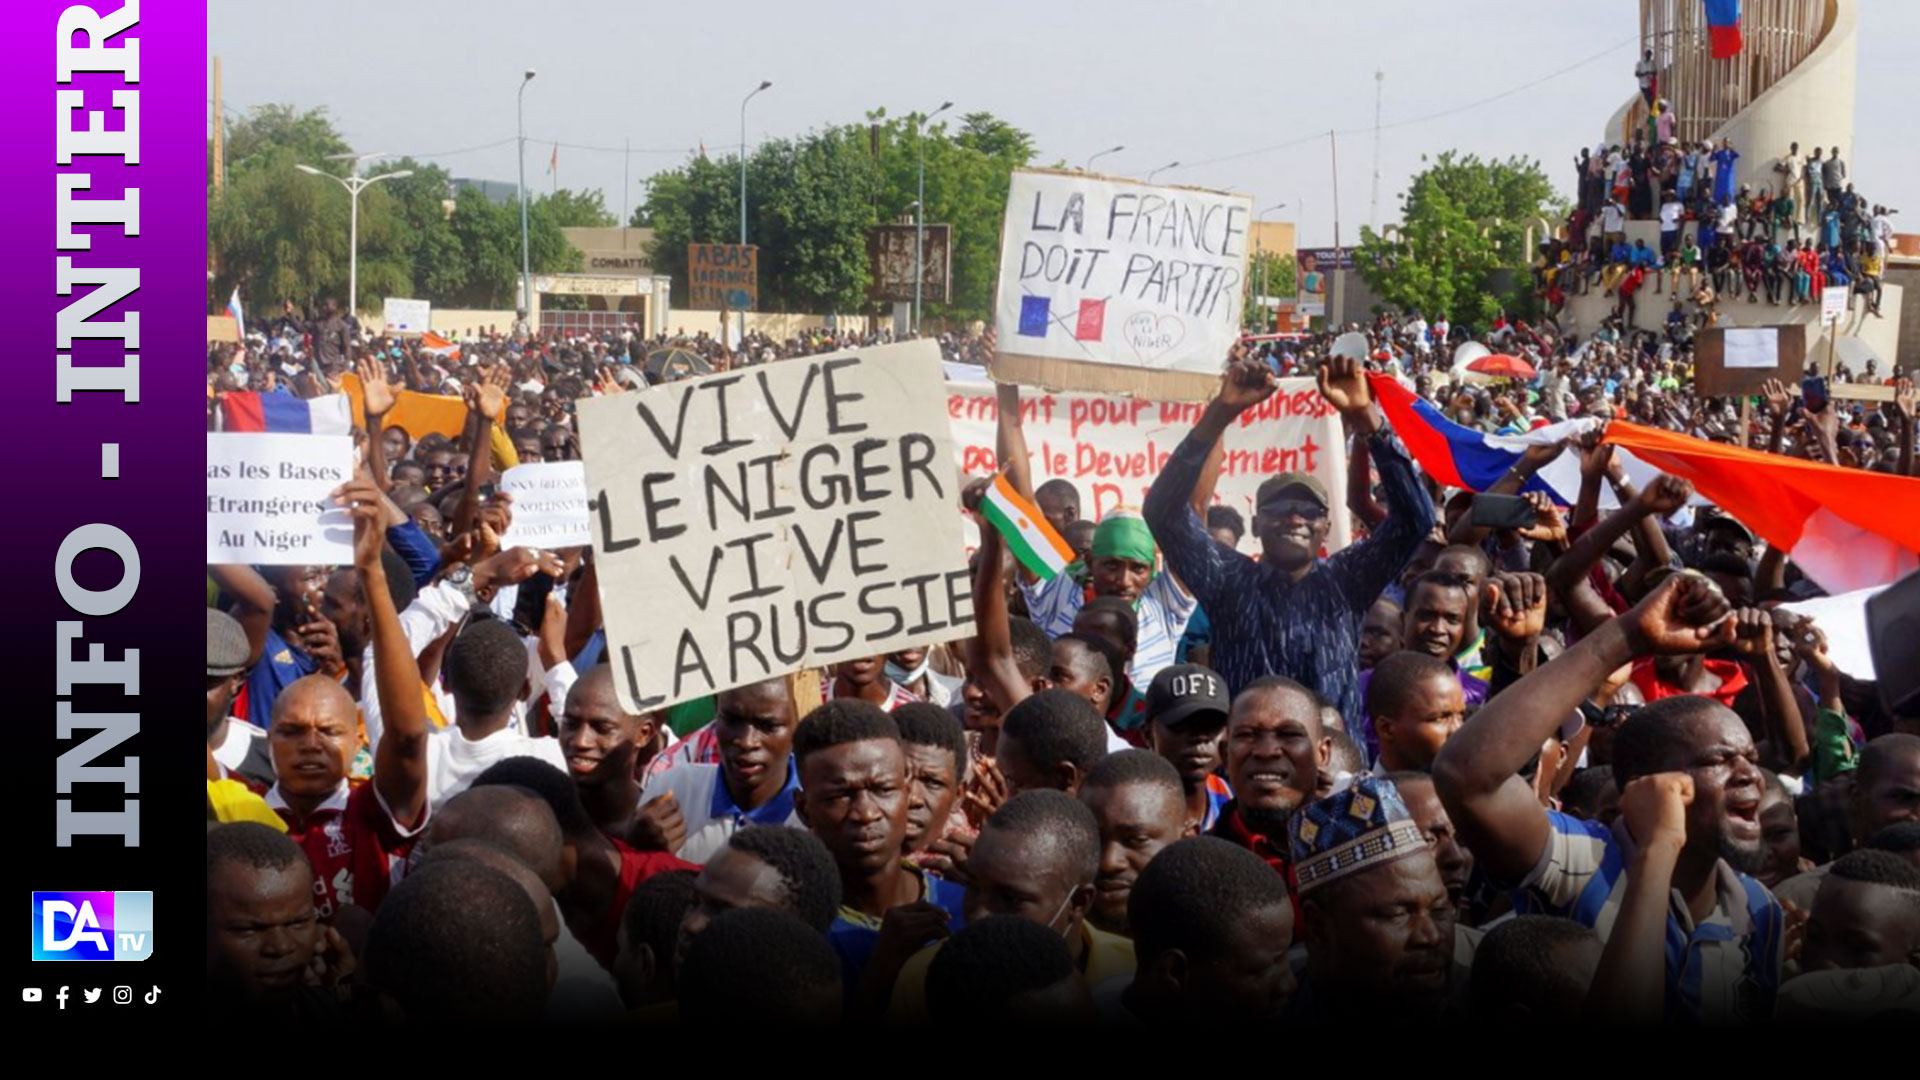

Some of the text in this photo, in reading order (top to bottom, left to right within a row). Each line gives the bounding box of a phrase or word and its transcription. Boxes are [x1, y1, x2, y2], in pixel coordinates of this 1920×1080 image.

[1031, 191, 1247, 258] LA FRANCE
[1119, 253, 1240, 324] PARTIR
[637, 357, 867, 460] VIVE
[947, 393, 1057, 427] emnt
[1070, 396, 1154, 439] pour
[239, 461, 270, 479] les
[279, 461, 342, 480] Bases
[1042, 440, 1068, 477] le
[597, 432, 944, 554] LE NIGER
[218, 529, 313, 552] Au Niger
[669, 510, 888, 611] VIVE
[727, 569, 977, 684] RUSSIE
[1172, 673, 1217, 697] OFF
